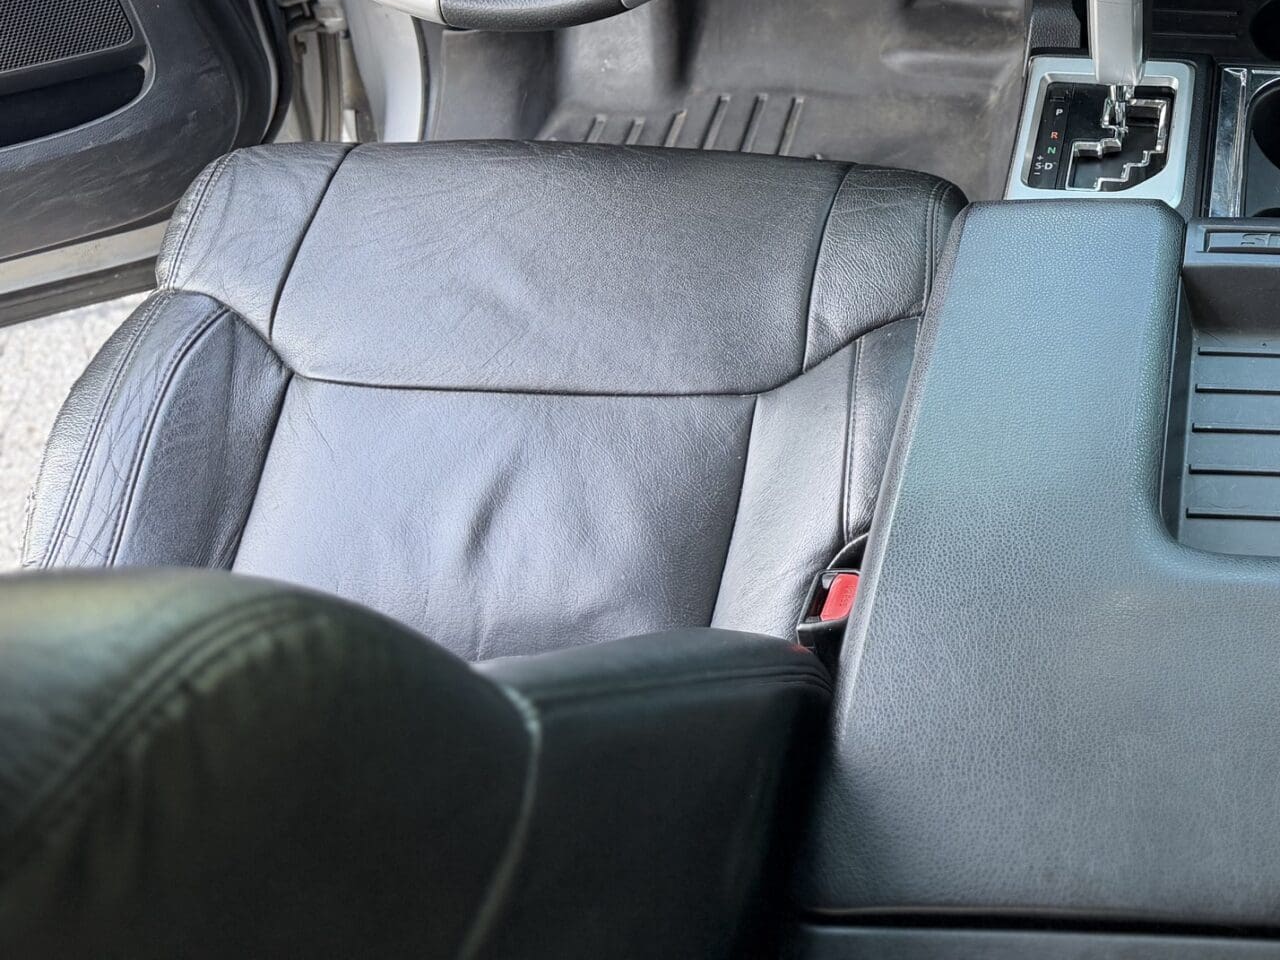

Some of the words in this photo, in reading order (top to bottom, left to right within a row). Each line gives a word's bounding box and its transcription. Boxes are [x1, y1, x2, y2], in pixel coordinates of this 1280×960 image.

[1055, 108, 1064, 116] P
[1050, 131, 1059, 139] R
[1047, 146, 1056, 155] N
